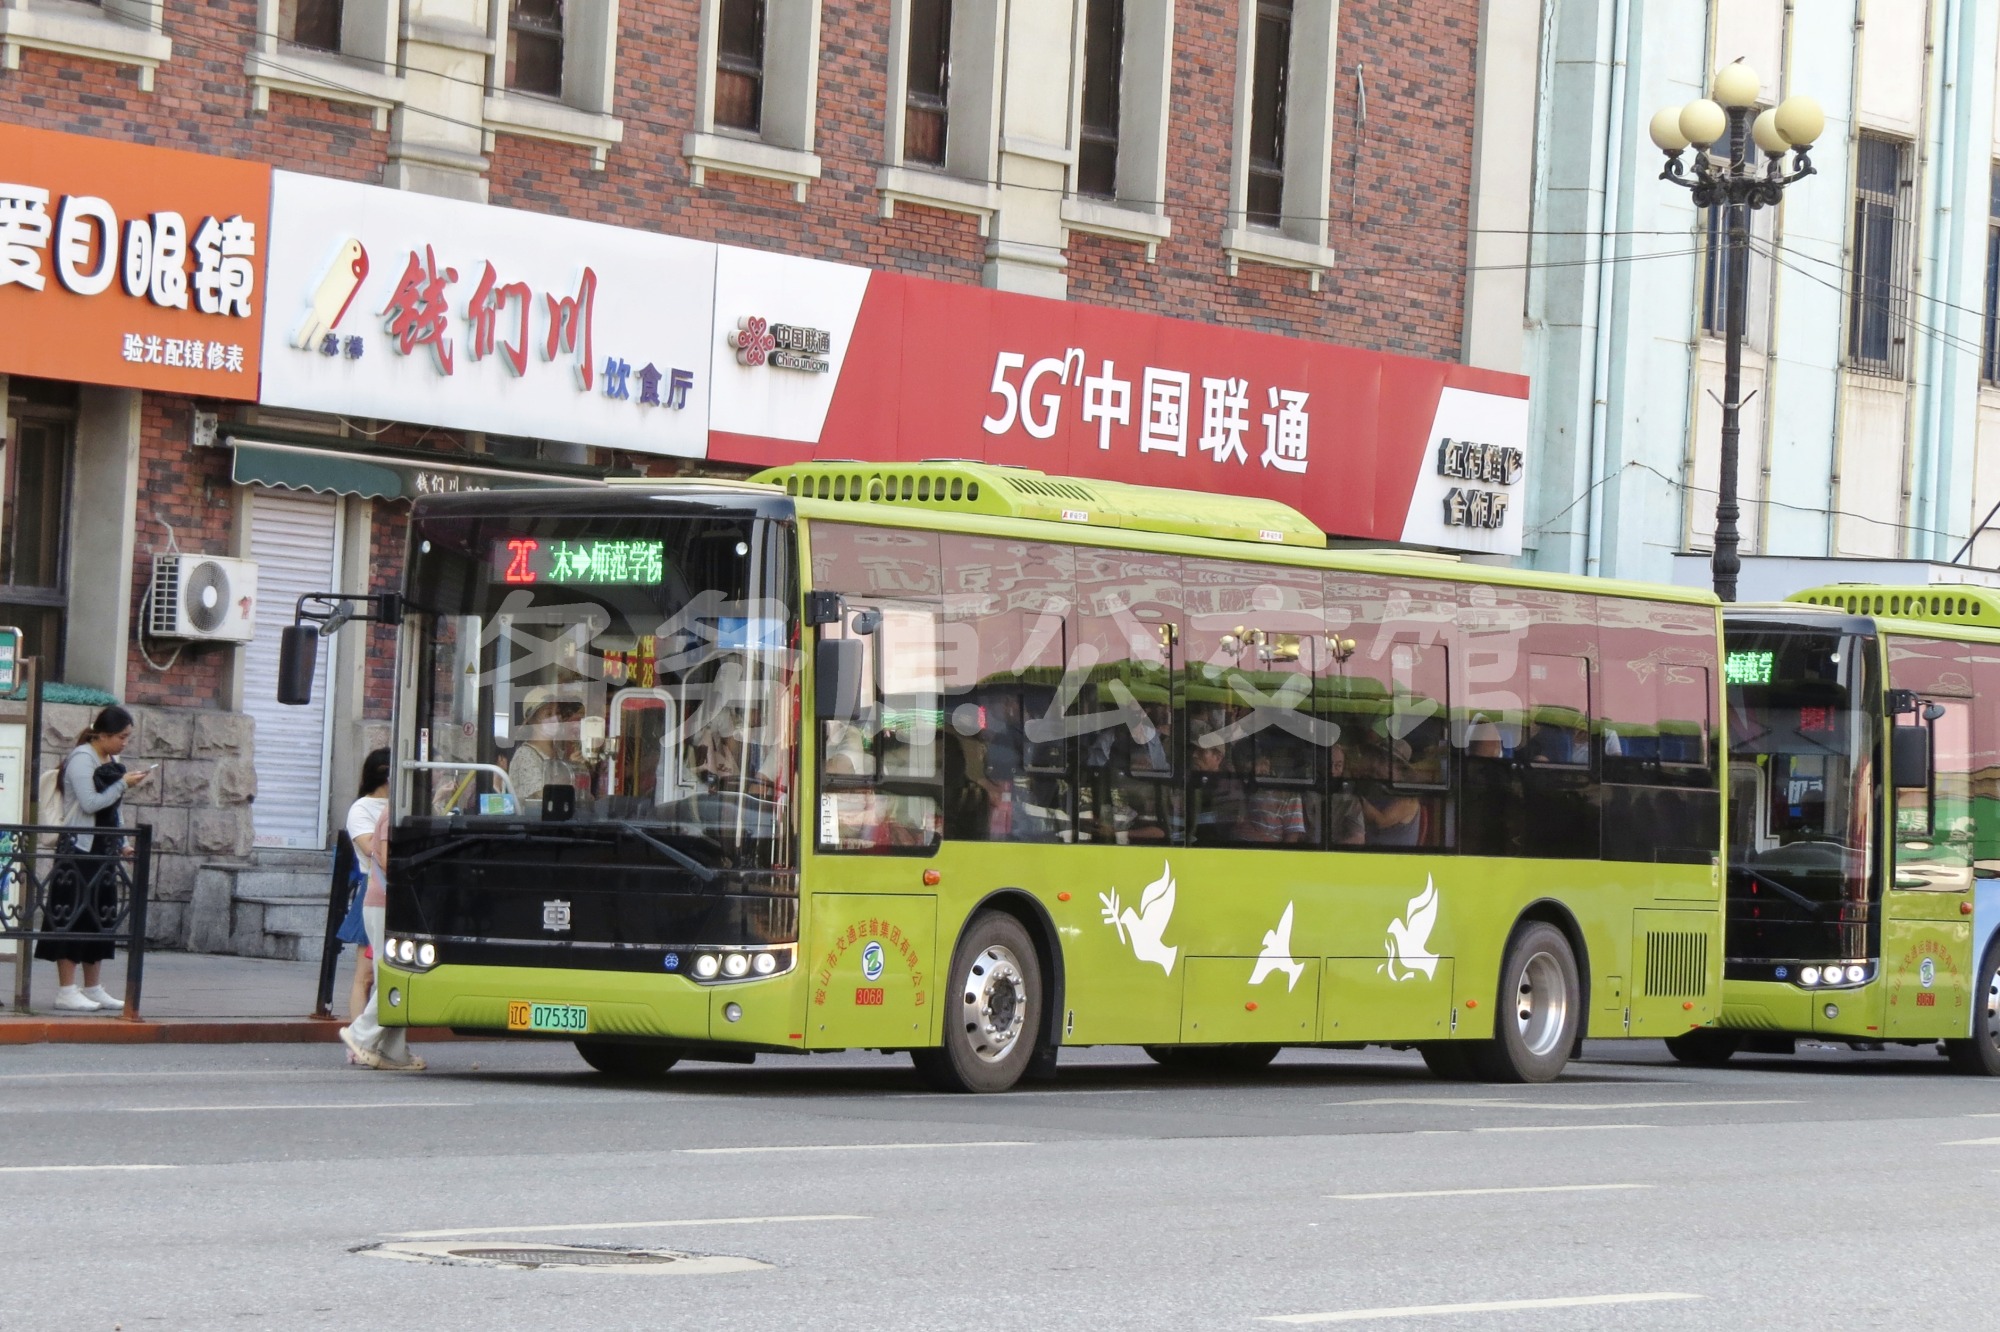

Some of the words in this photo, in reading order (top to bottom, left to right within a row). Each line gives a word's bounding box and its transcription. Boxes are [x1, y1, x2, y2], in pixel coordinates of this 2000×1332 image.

[0, 182, 255, 318] 爱目眼镜
[122, 332, 244, 373] 验光配镜修表
[777, 324, 830, 354] 中国联通
[602, 356, 693, 409] 饮食厅
[776, 352, 799, 367] China
[801, 356, 828, 373] unicom
[1083, 359, 1310, 474] 中国联通
[1445, 488, 1509, 528] 合作厅
[505, 540, 538, 583] 2C
[590, 540, 664, 583] 师范学院
[856, 988, 883, 1005] 3068
[510, 1005, 528, 1025] 辽C
[534, 1006, 587, 1029] 07533D
